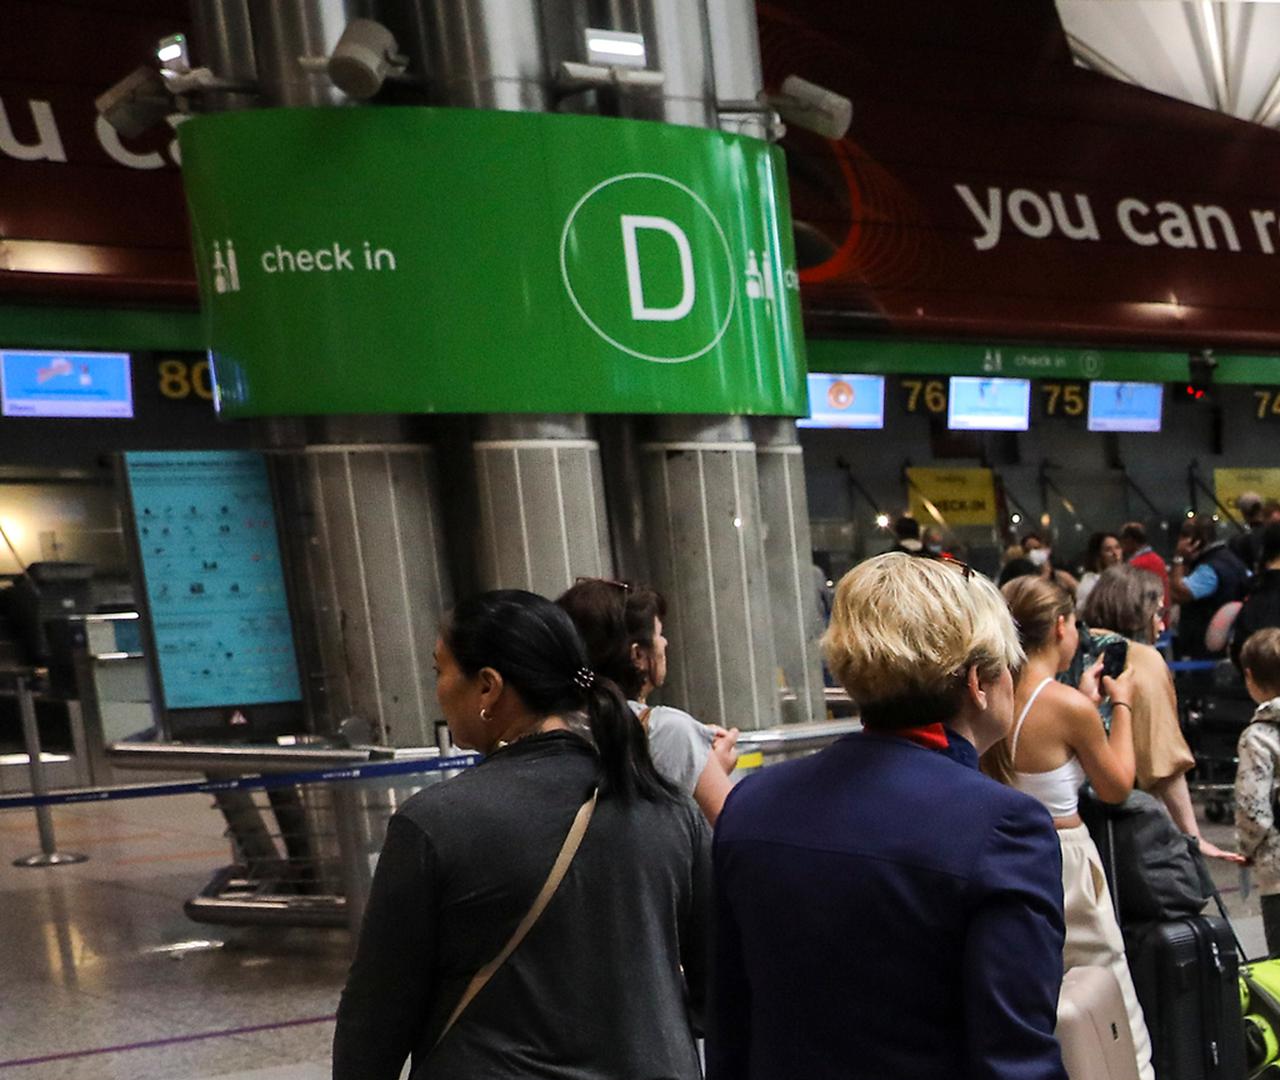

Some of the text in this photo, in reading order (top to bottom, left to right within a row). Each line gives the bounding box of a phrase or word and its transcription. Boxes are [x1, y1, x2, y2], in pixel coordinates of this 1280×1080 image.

[954, 184, 1100, 251] you
[1116, 197, 1241, 252] can
[261, 240, 397, 274] check in
[620, 213, 696, 322] D
[902, 380, 945, 414] 76
[1042, 384, 1085, 416] 75
